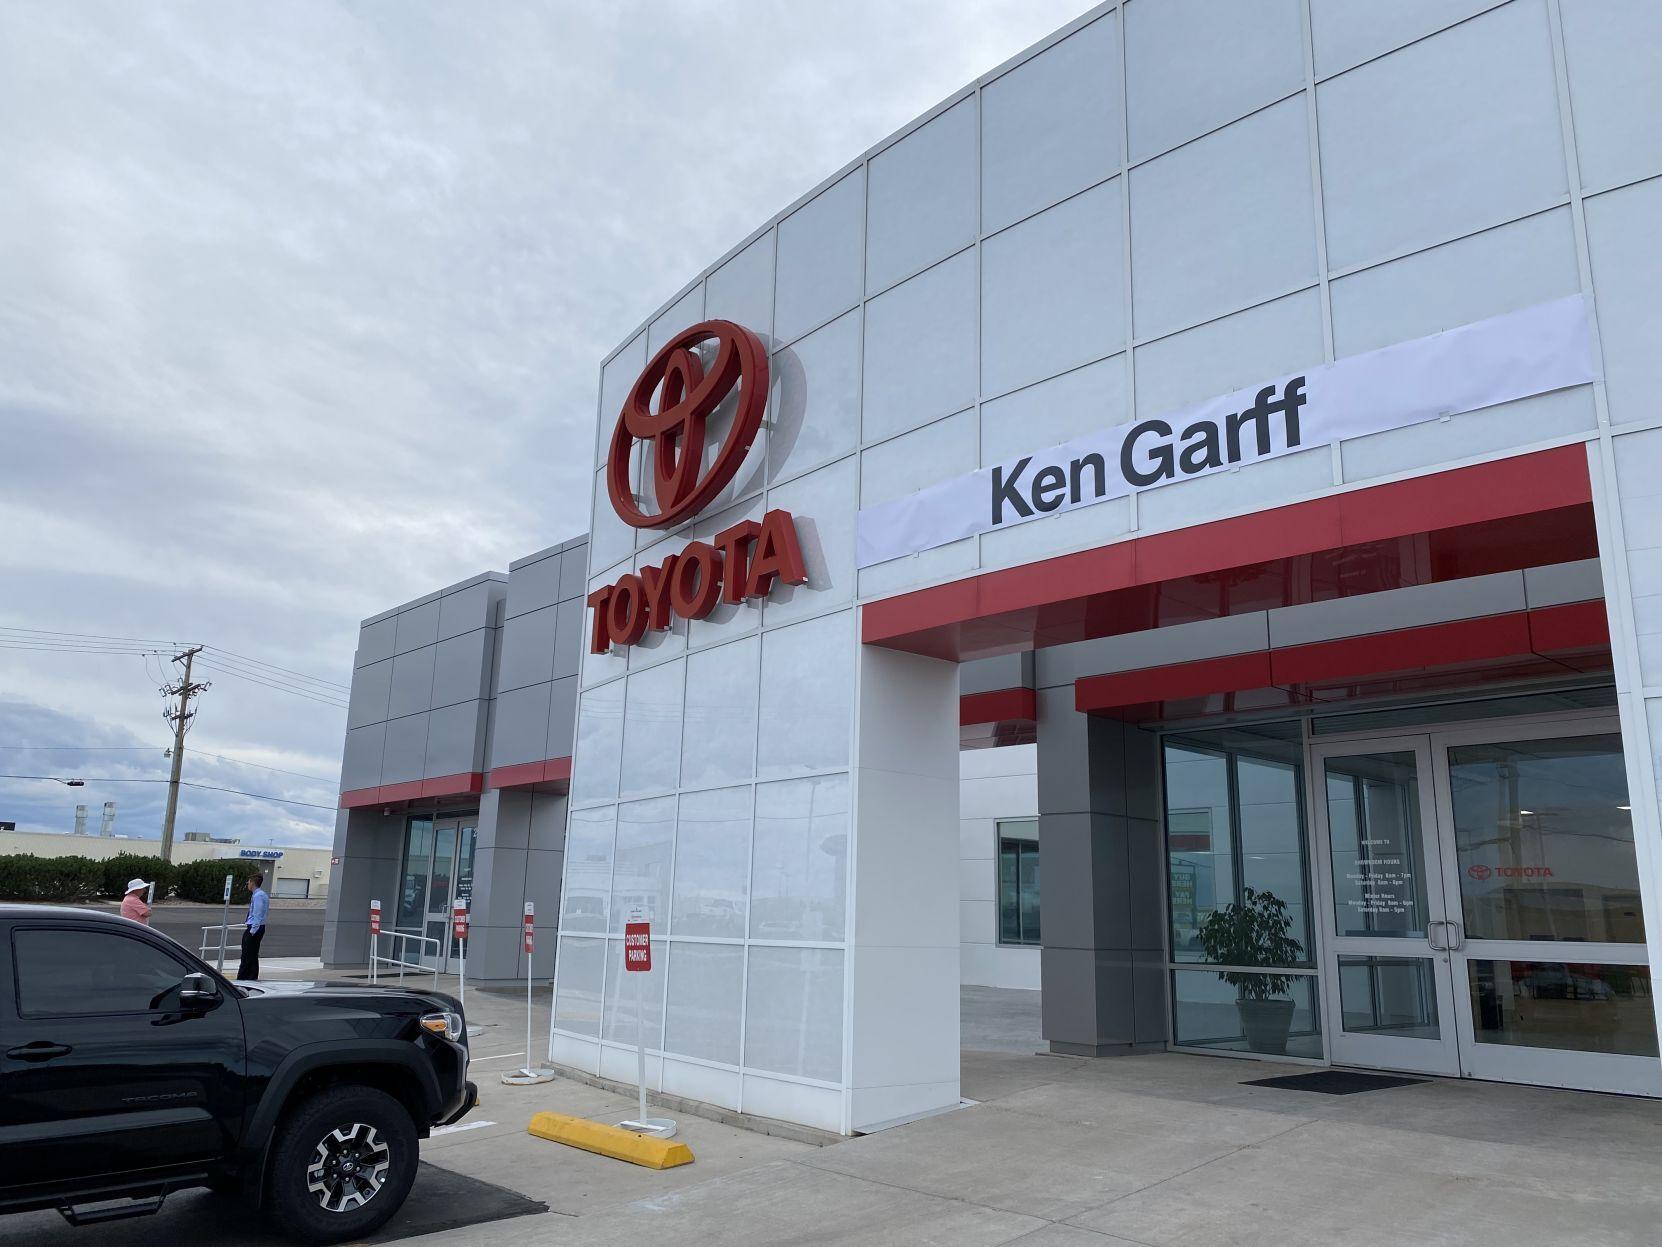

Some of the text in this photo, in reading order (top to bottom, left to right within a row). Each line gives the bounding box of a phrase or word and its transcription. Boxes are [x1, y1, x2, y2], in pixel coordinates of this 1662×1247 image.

[991, 376, 1307, 526] Ken Garff
[587, 508, 808, 655] TOYOTA
[240, 849, 284, 859] BODY SHOP
[1495, 866, 1553, 878] TOYOTA
[626, 934, 649, 946] CUSTOMER
[628, 949, 647, 962] PARKING
[121, 1091, 198, 1104] TACOMA
